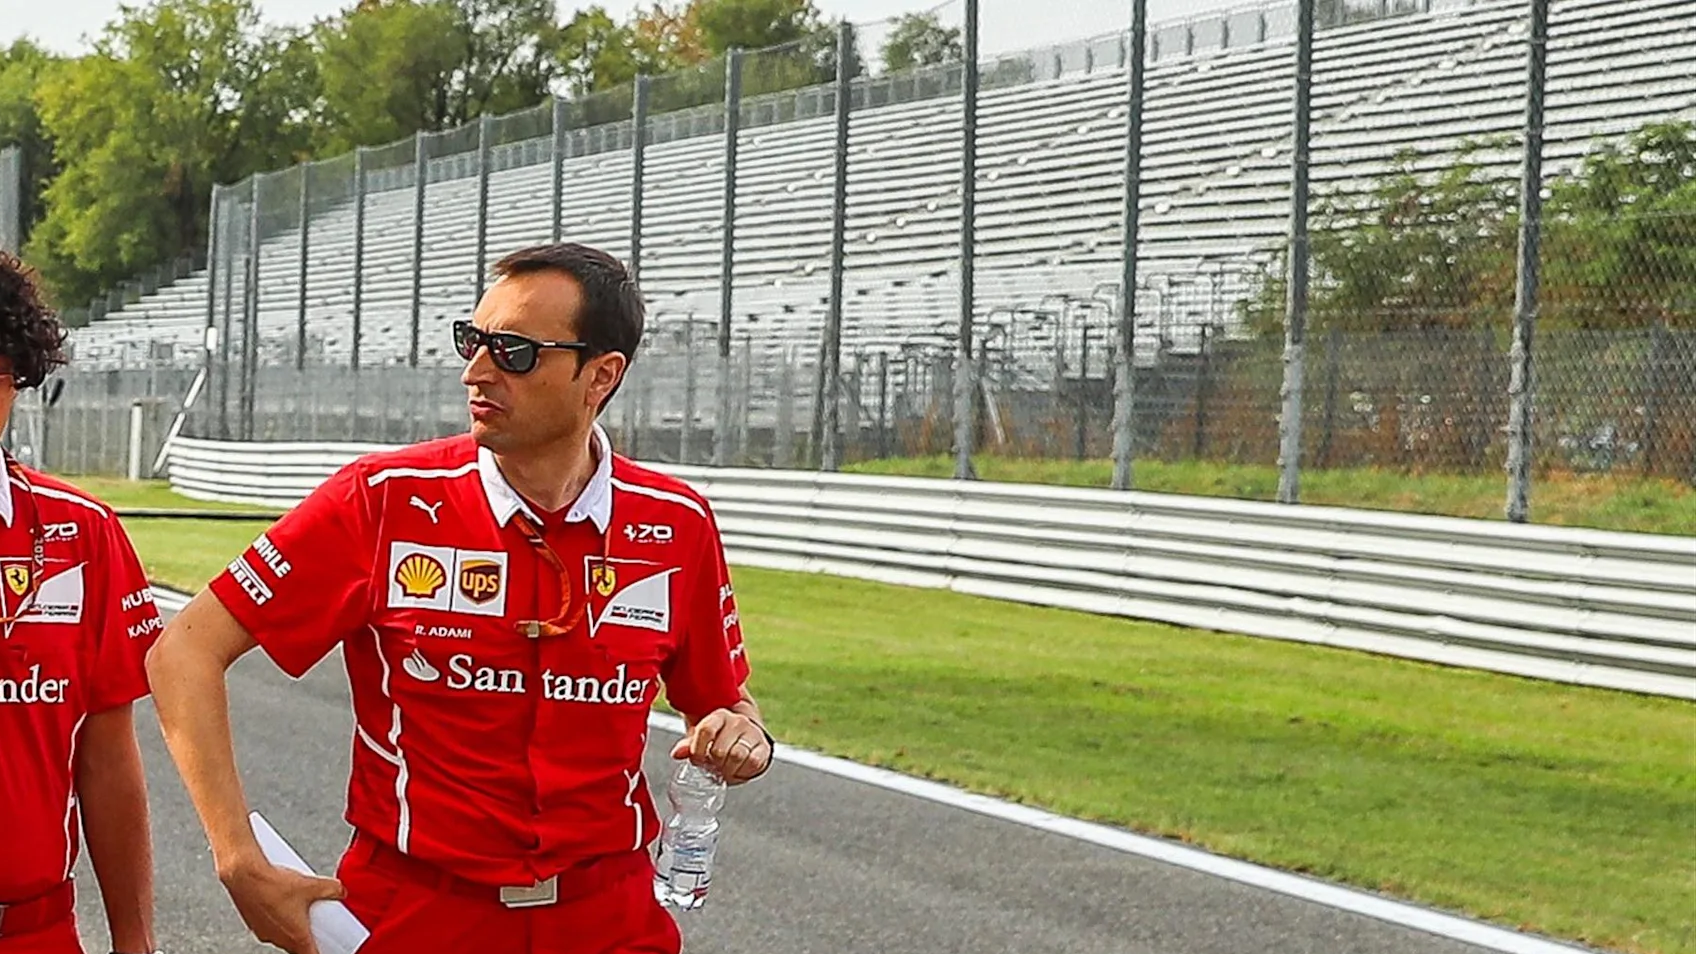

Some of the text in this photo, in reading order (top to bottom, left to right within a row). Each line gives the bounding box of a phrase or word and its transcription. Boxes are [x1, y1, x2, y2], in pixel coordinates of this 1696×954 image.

[637, 523, 673, 540] 70
[461, 571, 499, 598] ups
[428, 626, 472, 639] ADAMI
[447, 654, 651, 704] Santander
